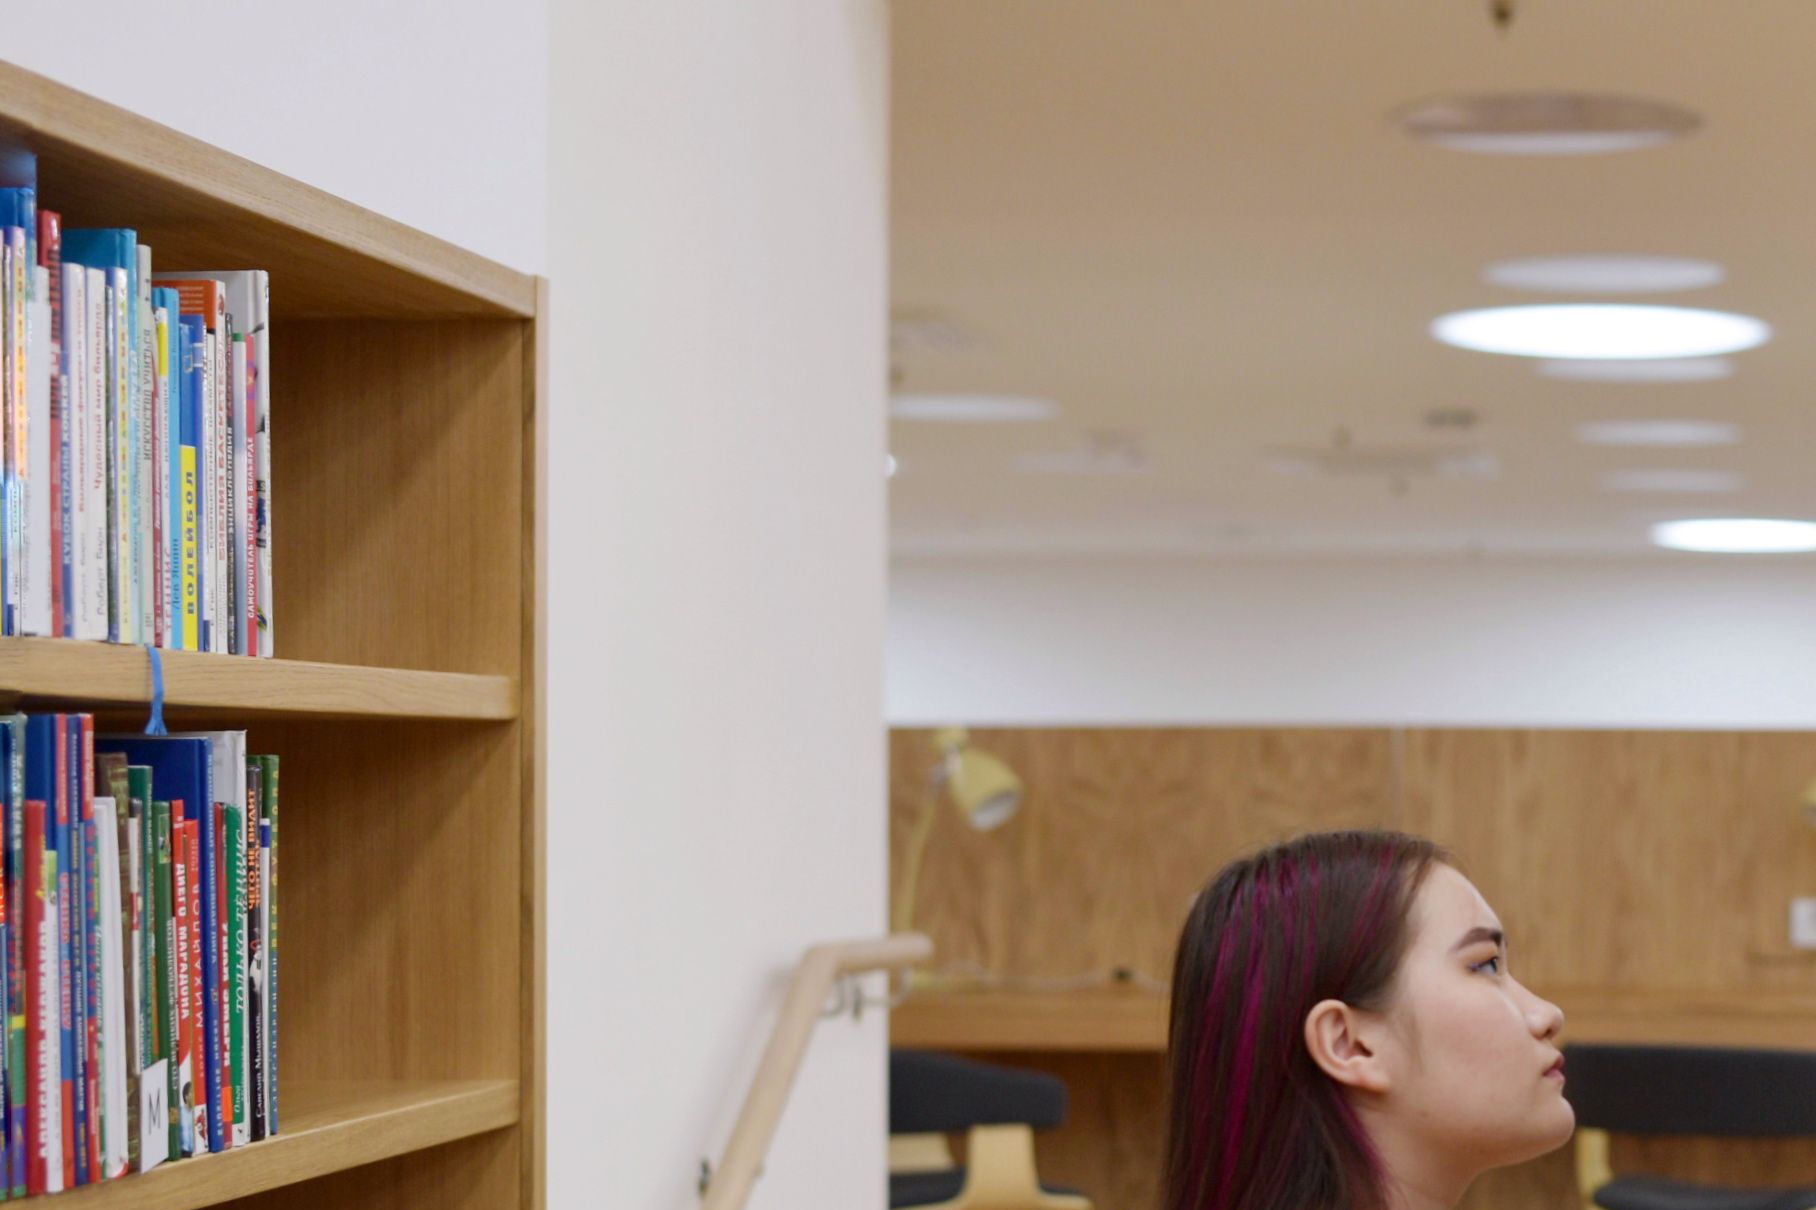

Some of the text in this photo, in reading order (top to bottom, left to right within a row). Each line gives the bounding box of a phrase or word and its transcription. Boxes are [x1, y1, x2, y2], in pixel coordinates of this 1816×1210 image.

[61, 446, 70, 509] СТРАНЫ
[246, 437, 254, 491] БИЛЬЯРДЕ
[62, 511, 71, 565] КУБОК
[247, 494, 255, 511] НА
[185, 471, 195, 615] ВОЛЕЙБОЛ
[248, 544, 256, 619] САМОУЧИТЕЛЬ
[246, 789, 256, 911] ЧЕГО НЕ ВИДИТ
[175, 863, 190, 1020] ДИЕГО МАРАДОНА
[190, 882, 204, 1029] МИХАЙЛОВ
[235, 928, 244, 1014] ТОЛЬКО
[148, 1088, 162, 1136] М
